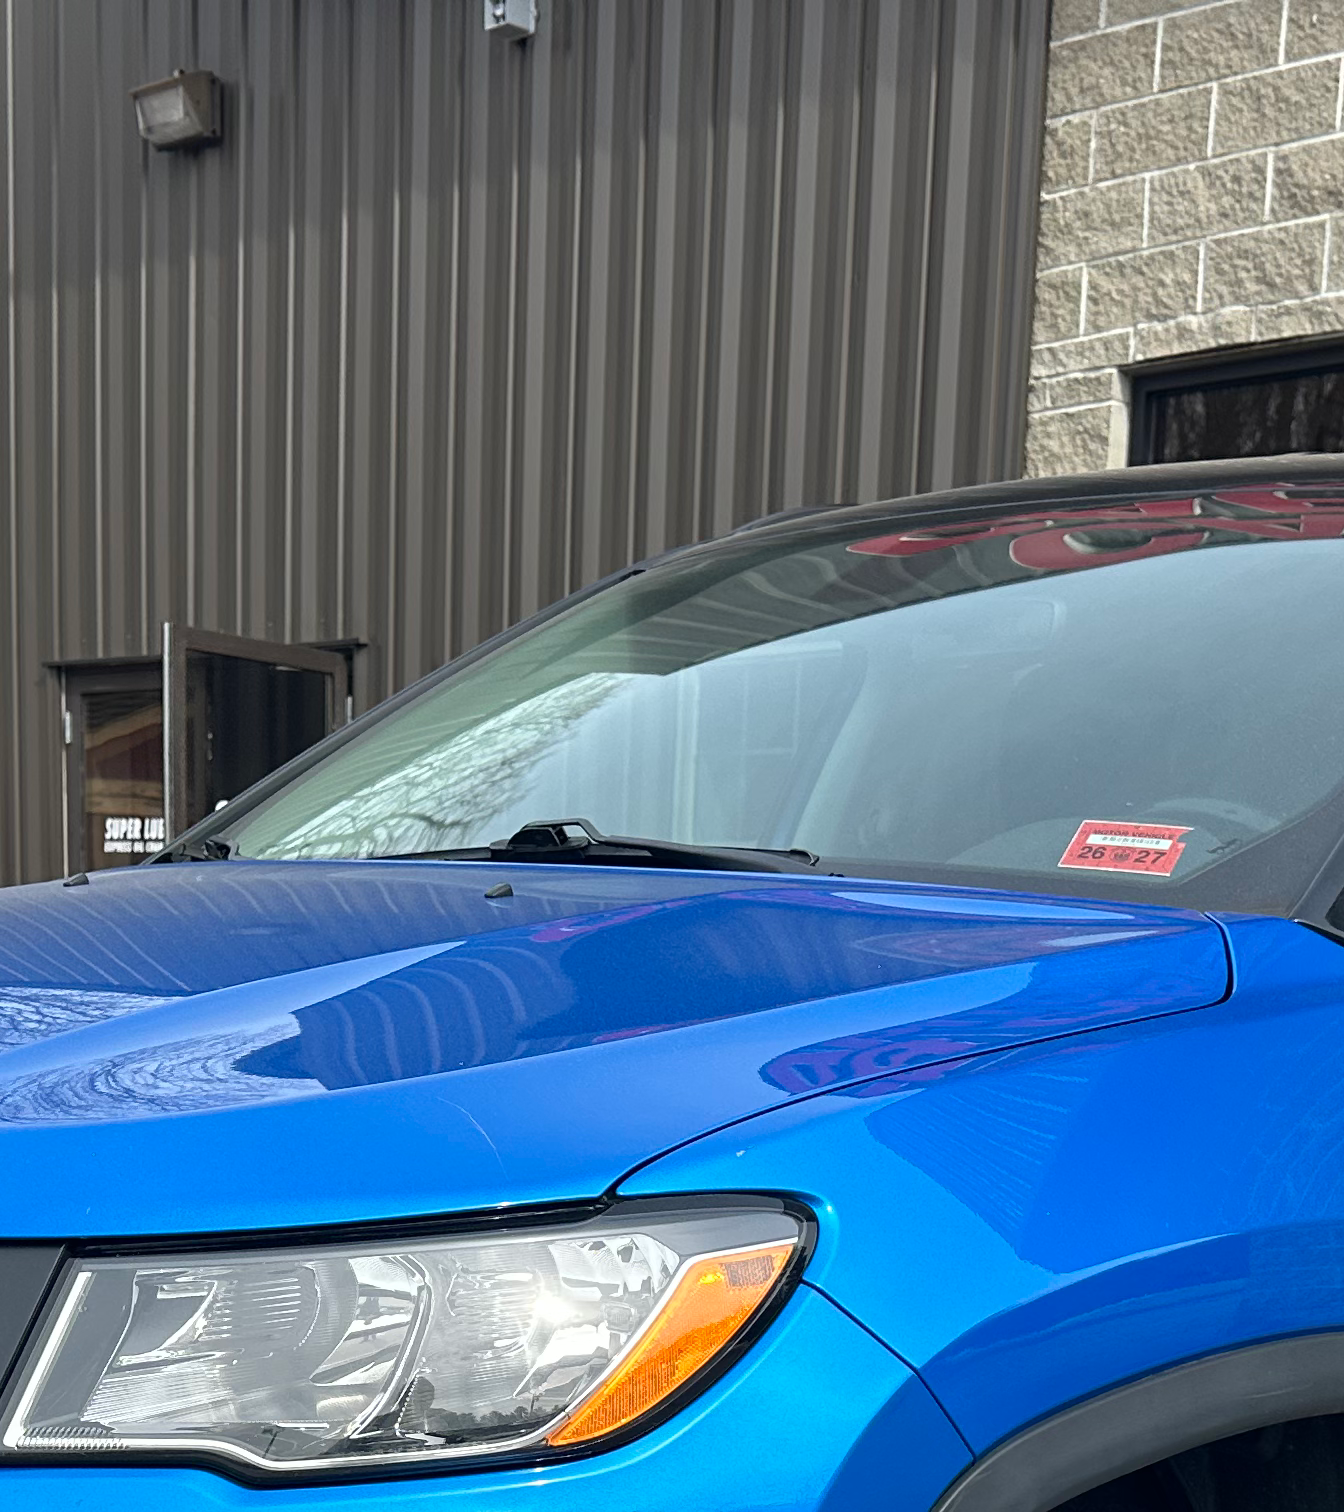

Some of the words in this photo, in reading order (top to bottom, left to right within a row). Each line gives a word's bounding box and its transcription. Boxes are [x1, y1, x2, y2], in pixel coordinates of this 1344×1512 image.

[105, 817, 142, 840] SUPER
[1077, 846, 1107, 860] 26
[1133, 850, 1168, 865] 27
